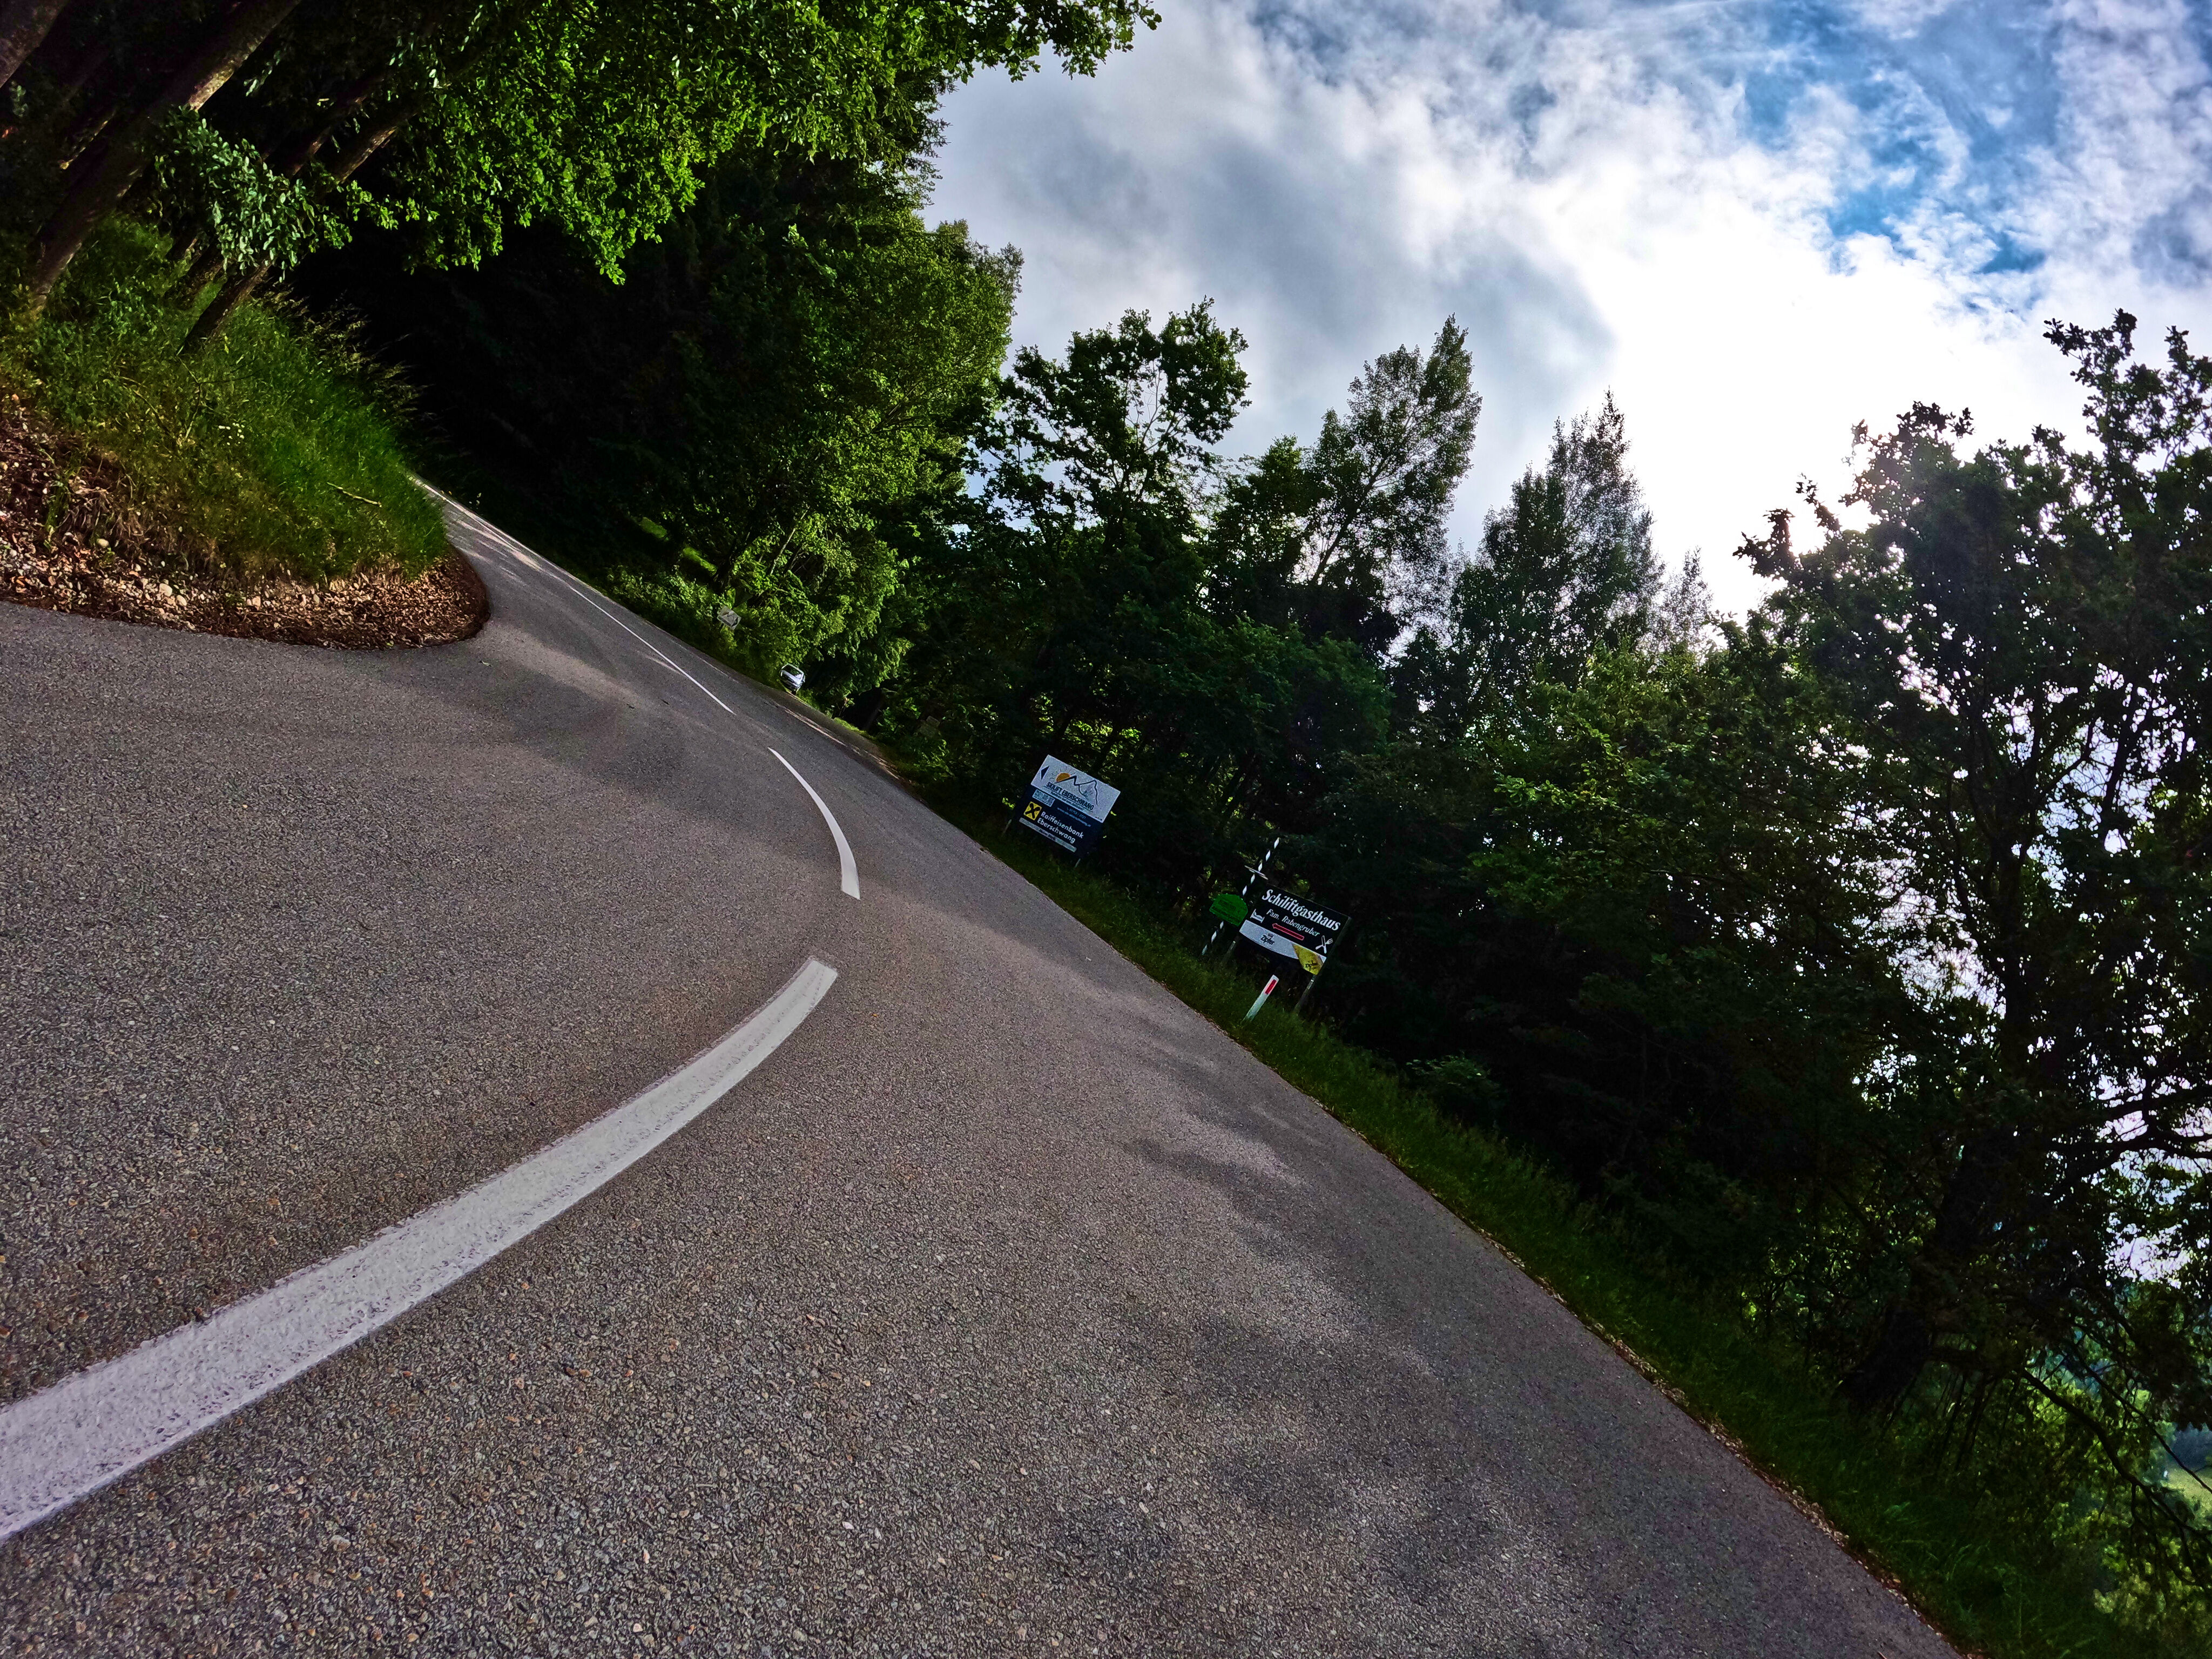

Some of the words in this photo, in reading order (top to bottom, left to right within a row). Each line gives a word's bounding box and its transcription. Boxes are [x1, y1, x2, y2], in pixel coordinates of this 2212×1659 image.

[1047, 781, 1062, 793] SKILIFT
[1062, 790, 1095, 811] EBERSCHWANG
[1037, 818, 1076, 844] Eberschwang
[1041, 811, 1084, 839] Raiffeisenbank
[1262, 889, 1340, 931] Schiliftgasthaus
[1266, 909, 1280, 920] Fam.
[1282, 916, 1320, 937] Rabengruber
[1260, 935, 1275, 946] Zipfer
